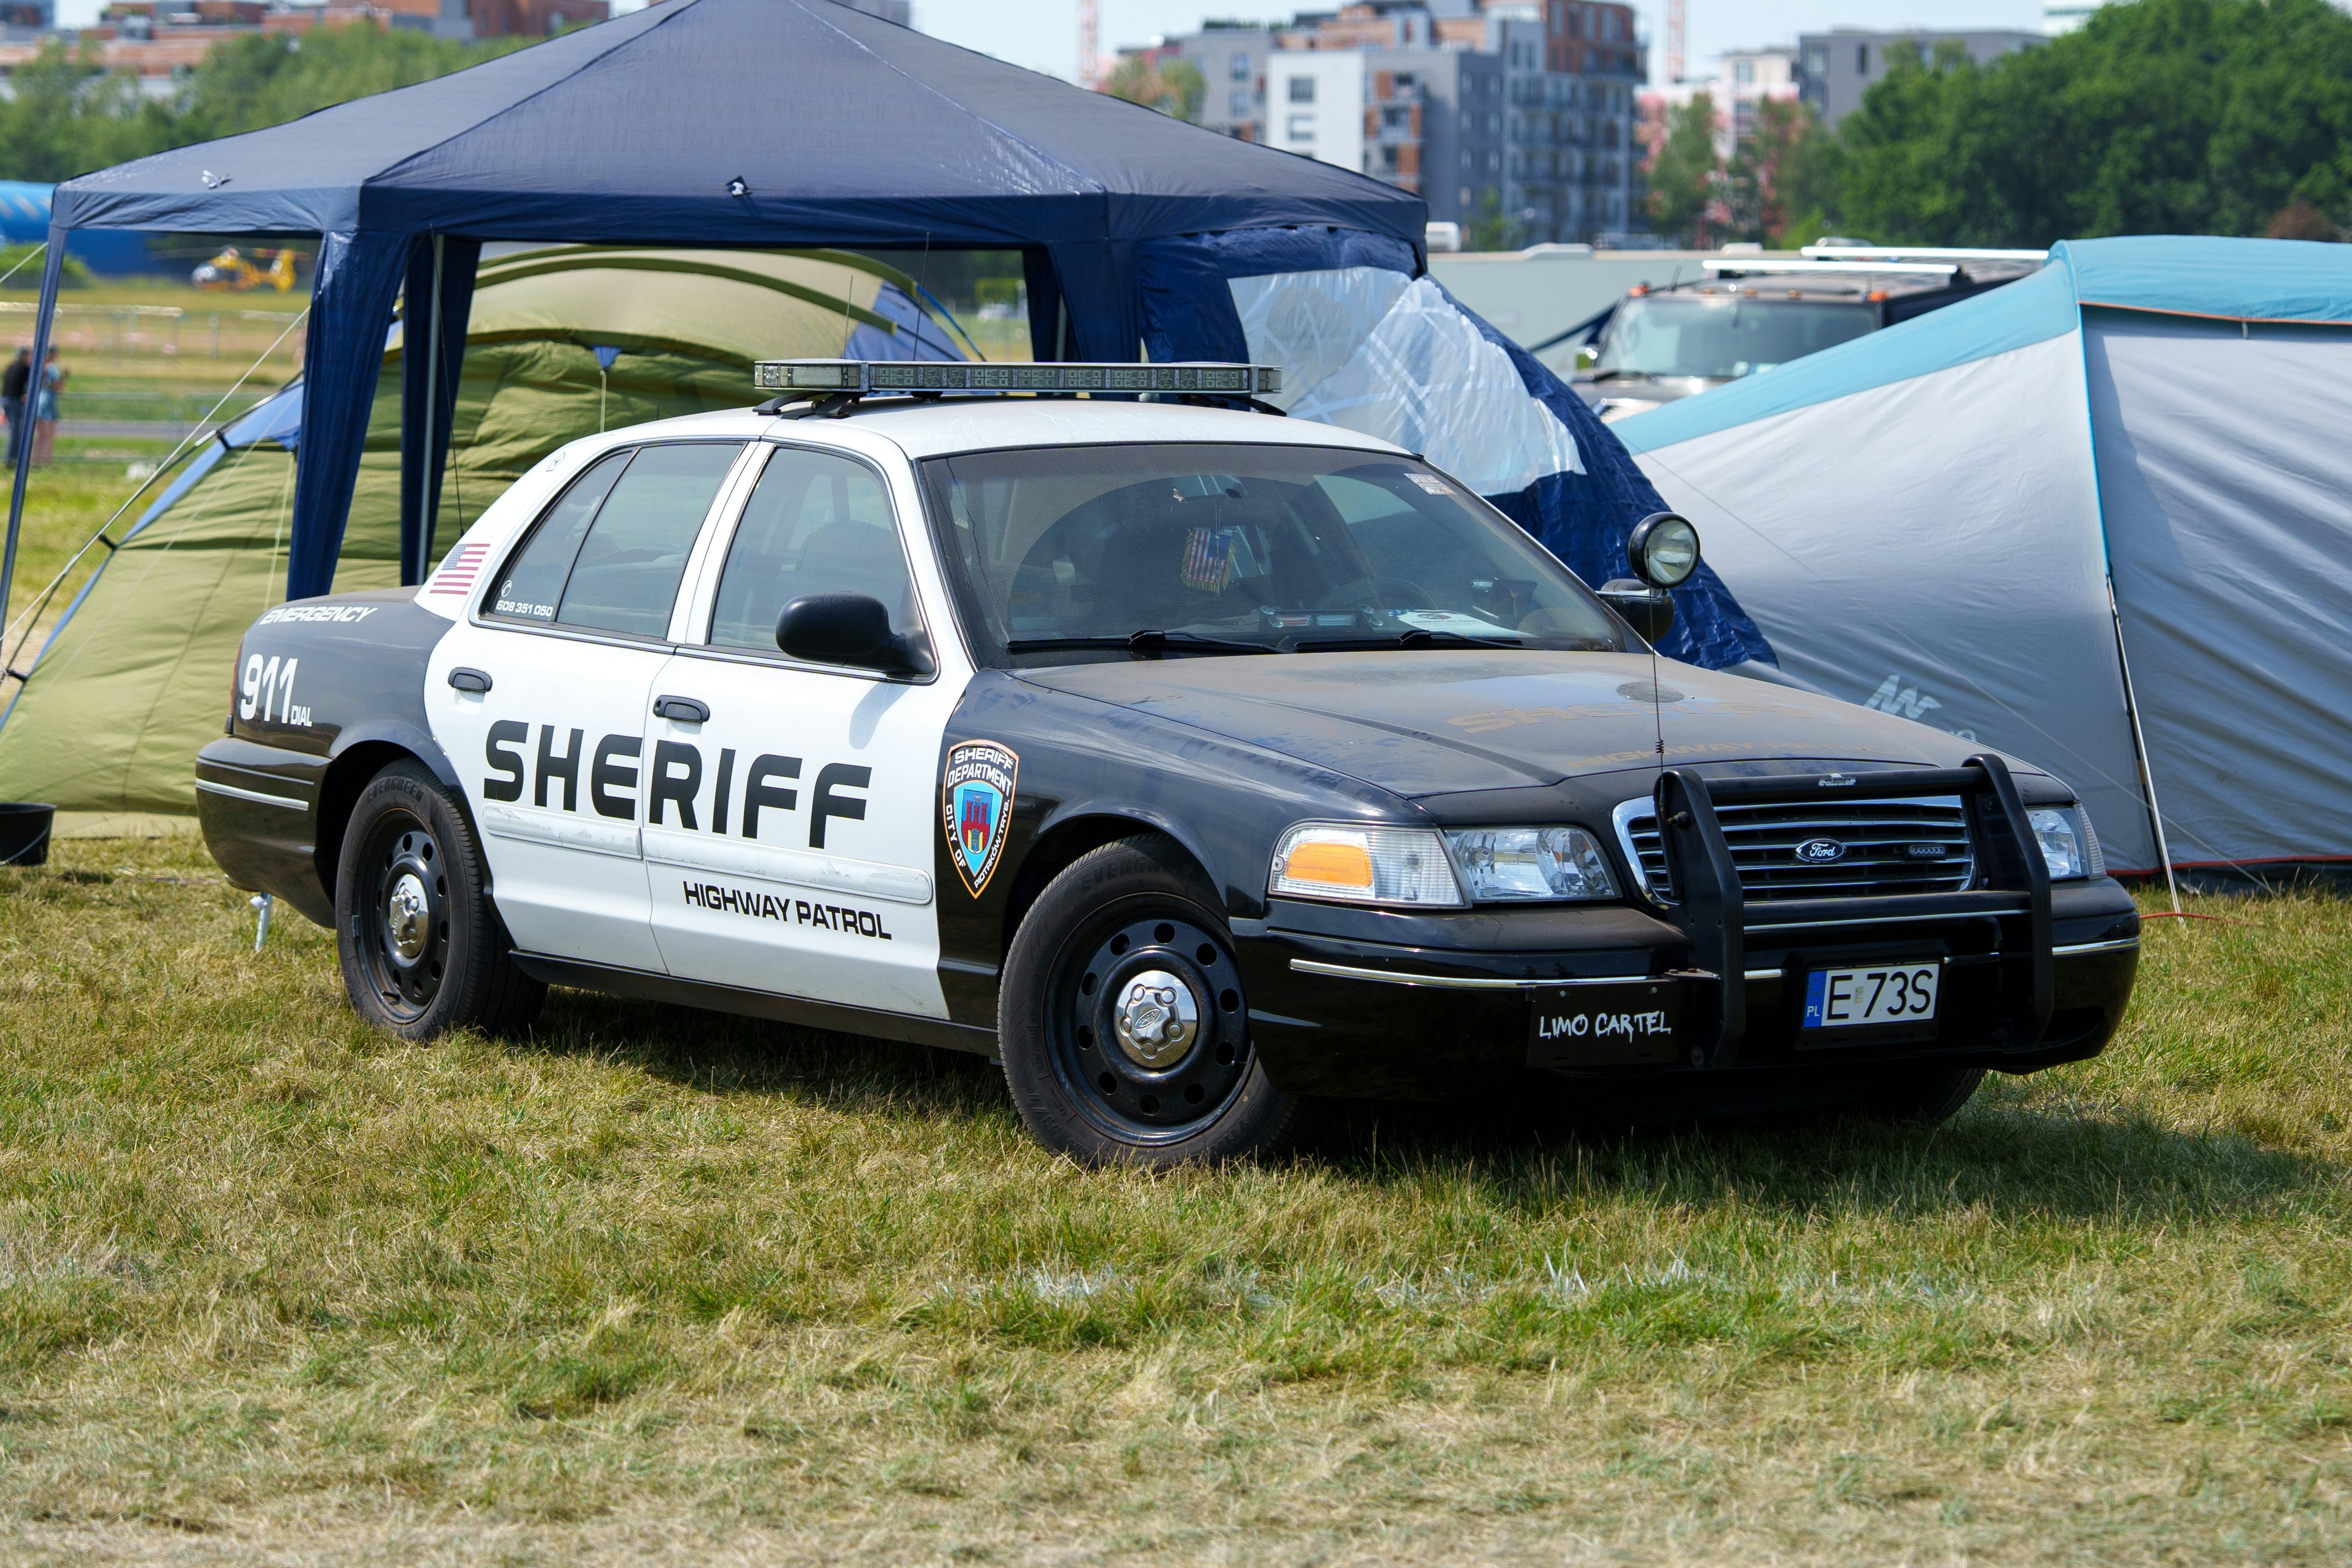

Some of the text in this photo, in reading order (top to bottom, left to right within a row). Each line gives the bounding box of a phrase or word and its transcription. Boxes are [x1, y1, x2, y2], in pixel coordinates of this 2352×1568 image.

[259, 606, 378, 625] EMERGENCY
[496, 600, 553, 617] 608 351 050
[240, 653, 298, 723] 911
[290, 705, 312, 727] DIAL
[1447, 702, 1836, 733] SHERIFF
[955, 747, 1013, 770] SHERIFF
[1565, 742, 1755, 769] HIGHWAY
[367, 777, 425, 805] EVERGREEN
[483, 719, 872, 849] SHERIFF
[947, 763, 1012, 796] DEPARTMENT
[946, 804, 966, 868] CITY OF
[974, 799, 1010, 888] PIOTRKÓW TRYB.
[1810, 843, 1836, 857] Ford
[683, 881, 892, 940] HIGHWAY PATROL
[1827, 969, 1933, 1020] E 73S
[1540, 1011, 1671, 1043] LIMO CARTEL
[1807, 1006, 1820, 1017] PL
